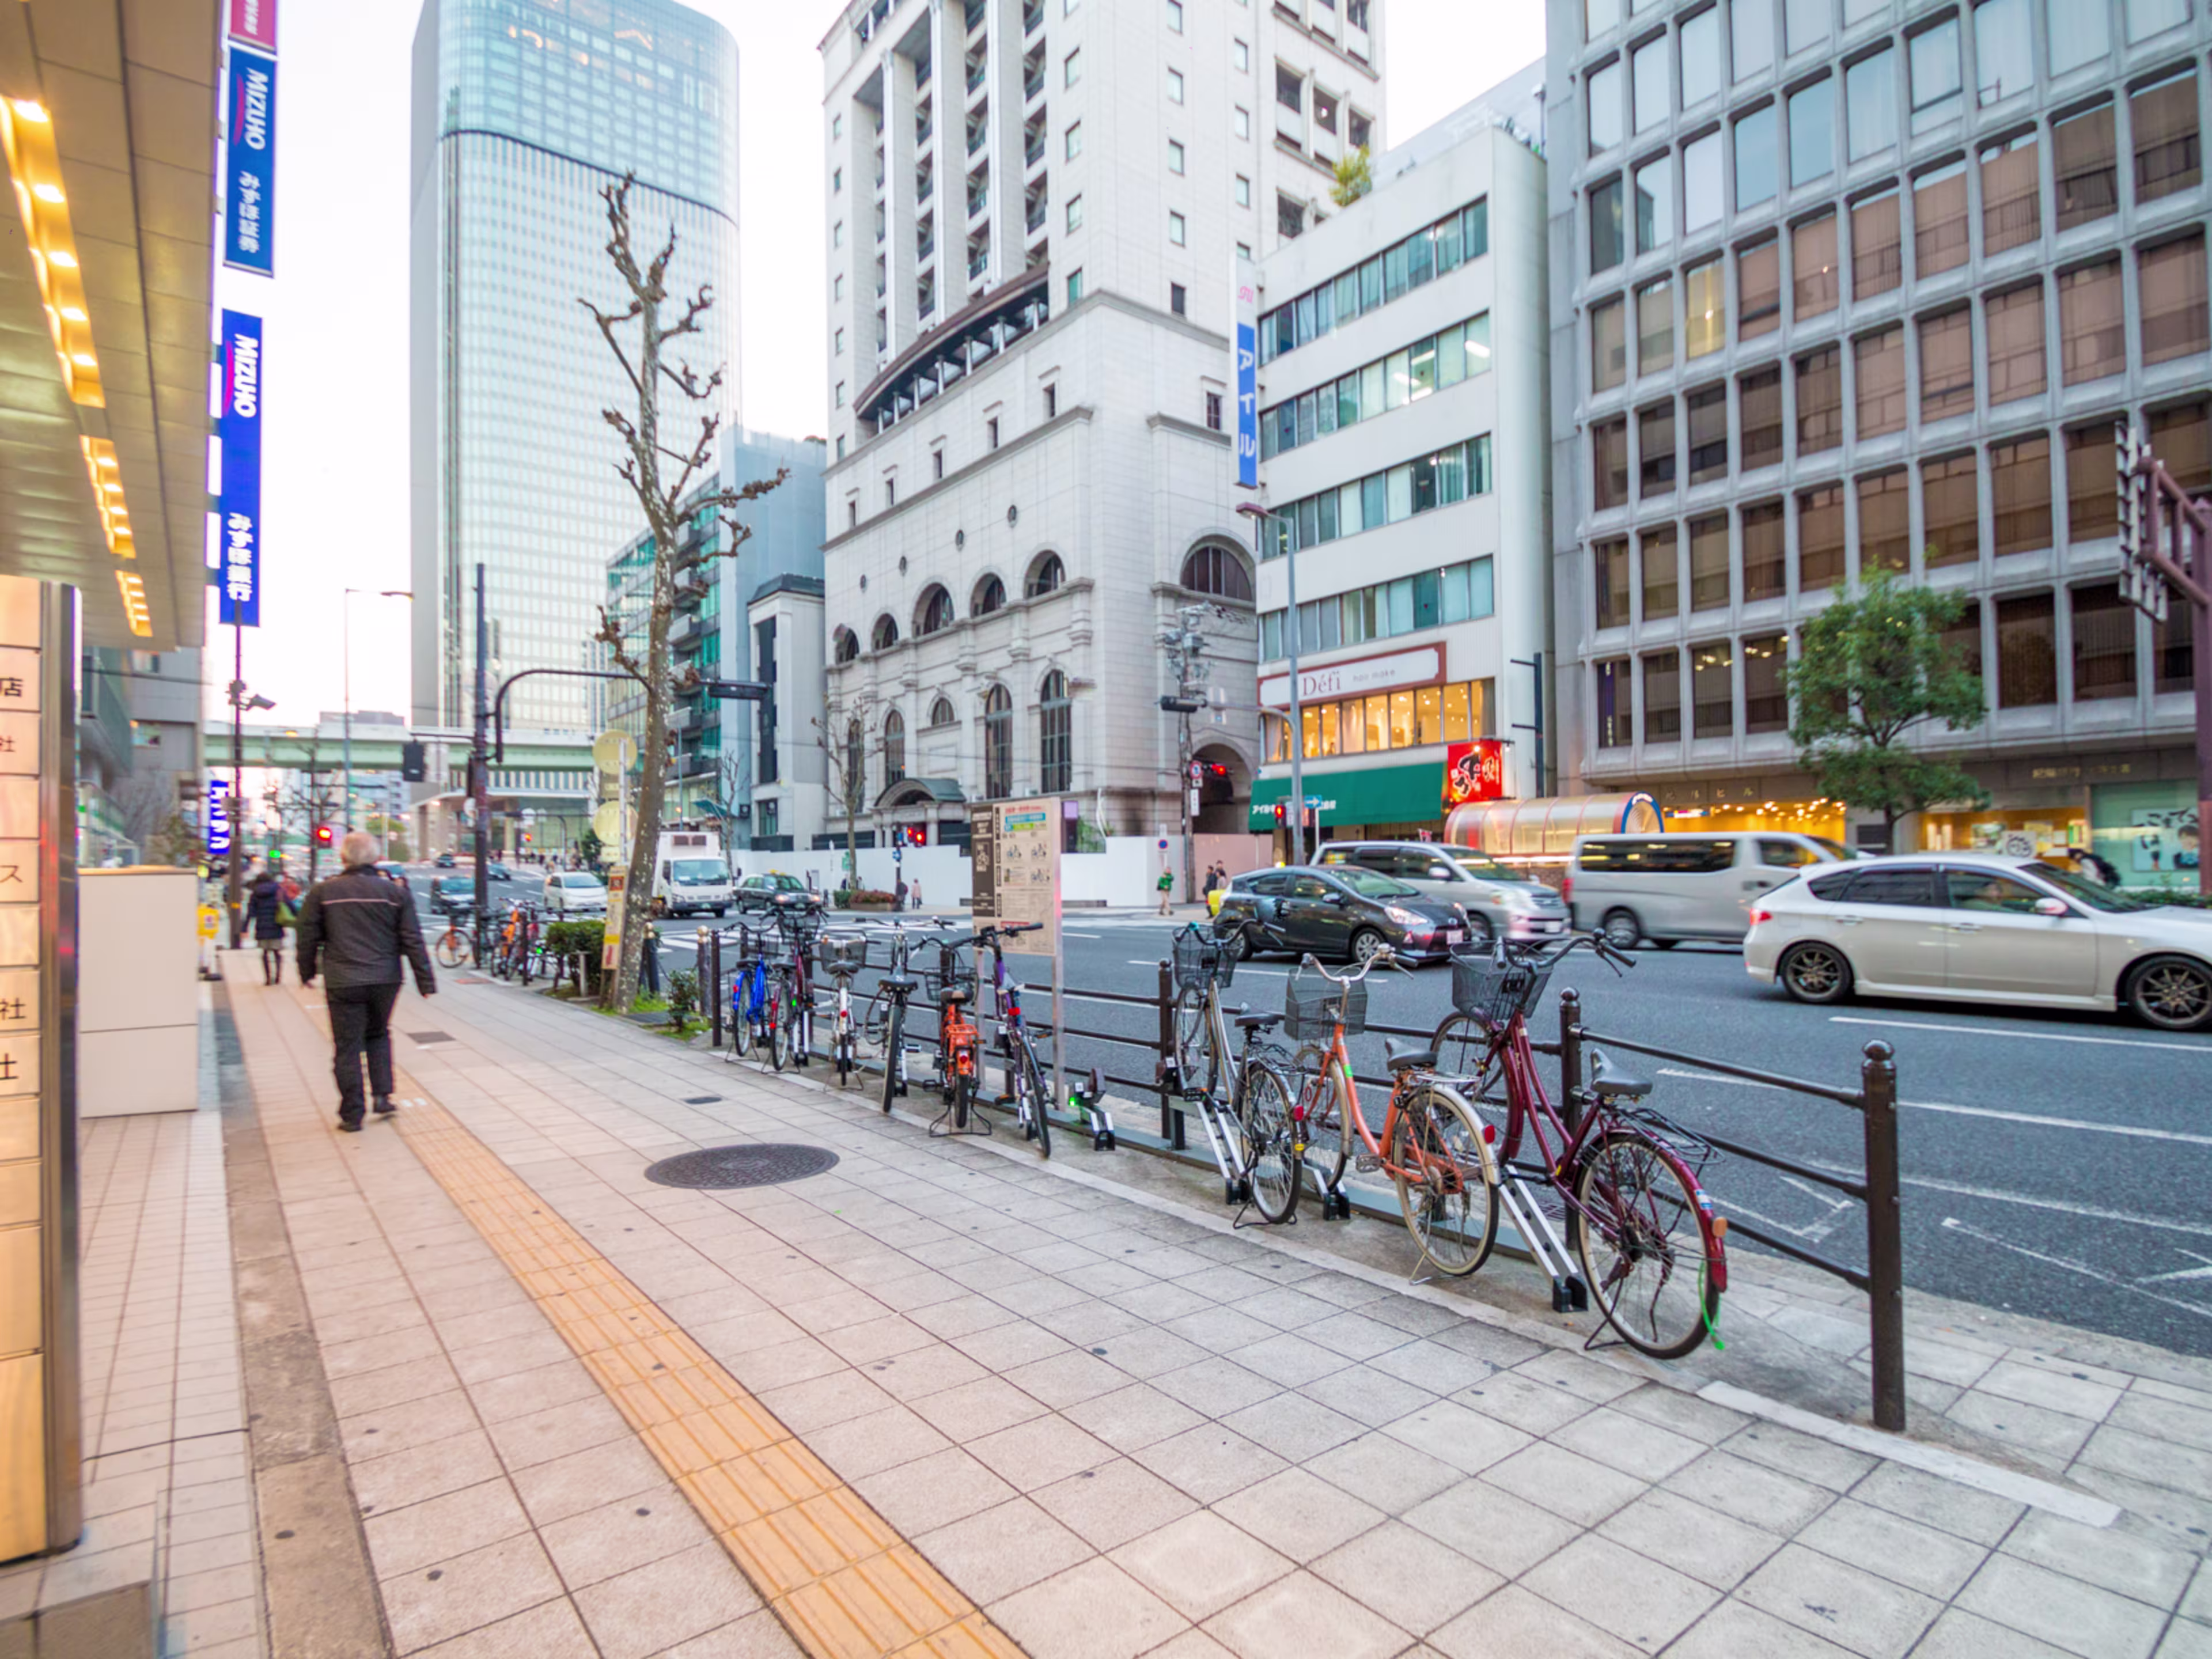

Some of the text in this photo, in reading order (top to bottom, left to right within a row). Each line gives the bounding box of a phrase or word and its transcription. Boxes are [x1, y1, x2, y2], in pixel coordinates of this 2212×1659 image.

[244, 67, 269, 150] MIZUHO
[234, 333, 259, 418] MIZUHO
[1239, 348, 1256, 457] アイル
[1302, 671, 1340, 696] Défi
